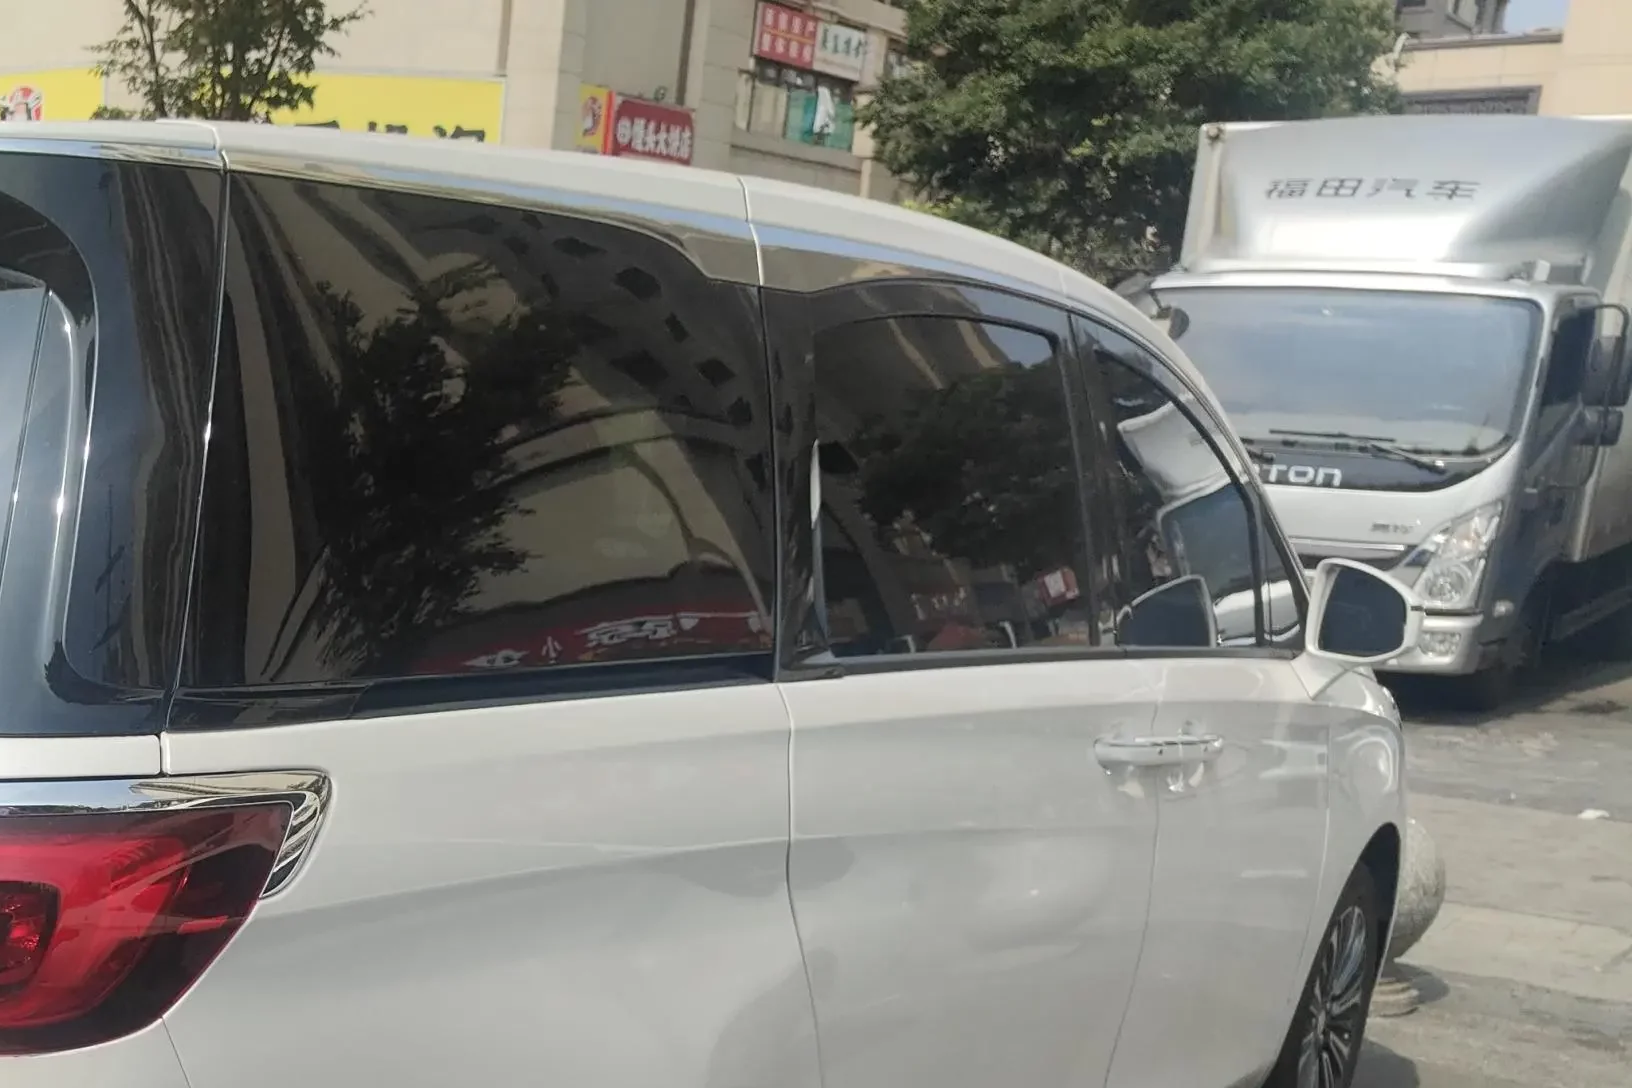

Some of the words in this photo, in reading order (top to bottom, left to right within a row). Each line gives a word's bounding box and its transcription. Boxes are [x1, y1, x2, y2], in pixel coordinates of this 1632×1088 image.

[1265, 177, 1481, 200] 福田汽车
[1254, 463, 1342, 487] TON
